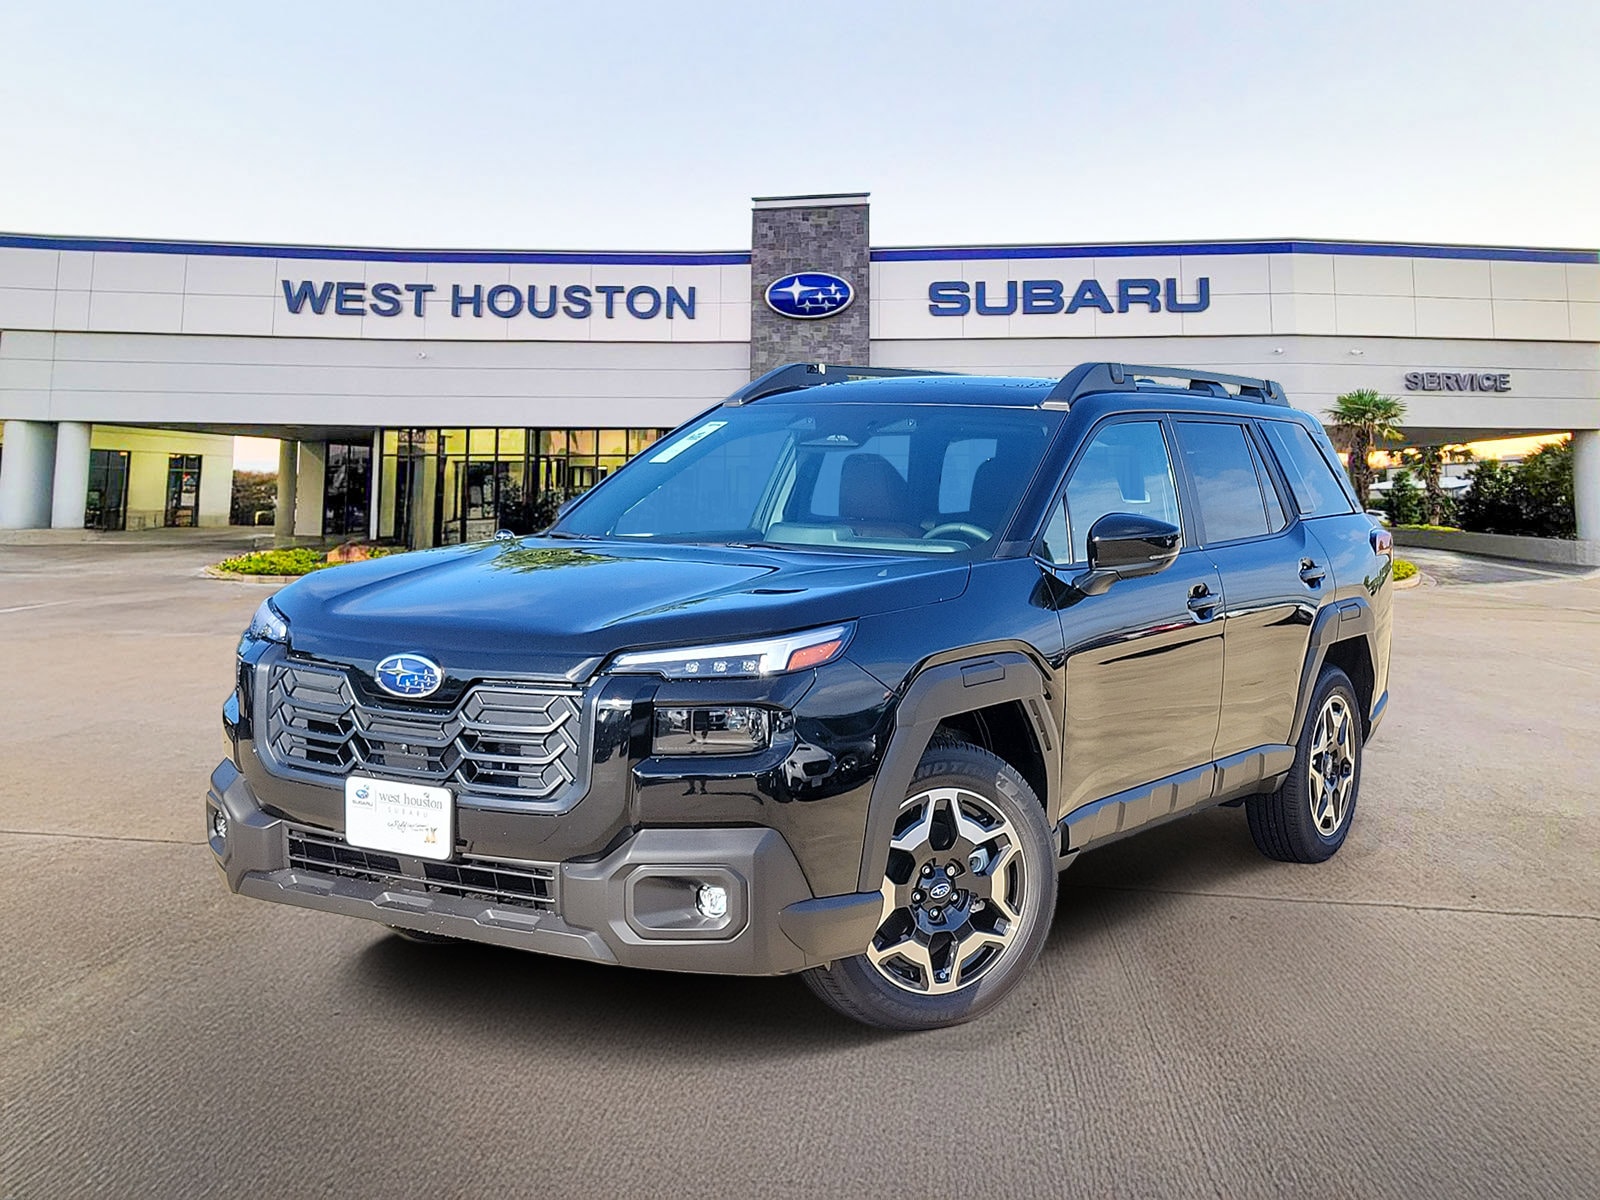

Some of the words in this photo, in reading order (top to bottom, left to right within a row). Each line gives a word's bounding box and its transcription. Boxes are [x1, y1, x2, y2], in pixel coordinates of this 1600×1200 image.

[281, 279, 437, 317] WEST
[451, 283, 697, 320] HOUSTON
[928, 277, 1210, 317] SUBARU
[1404, 372, 1512, 392] SERVICE
[378, 792, 400, 804] west
[403, 792, 443, 810] houston
